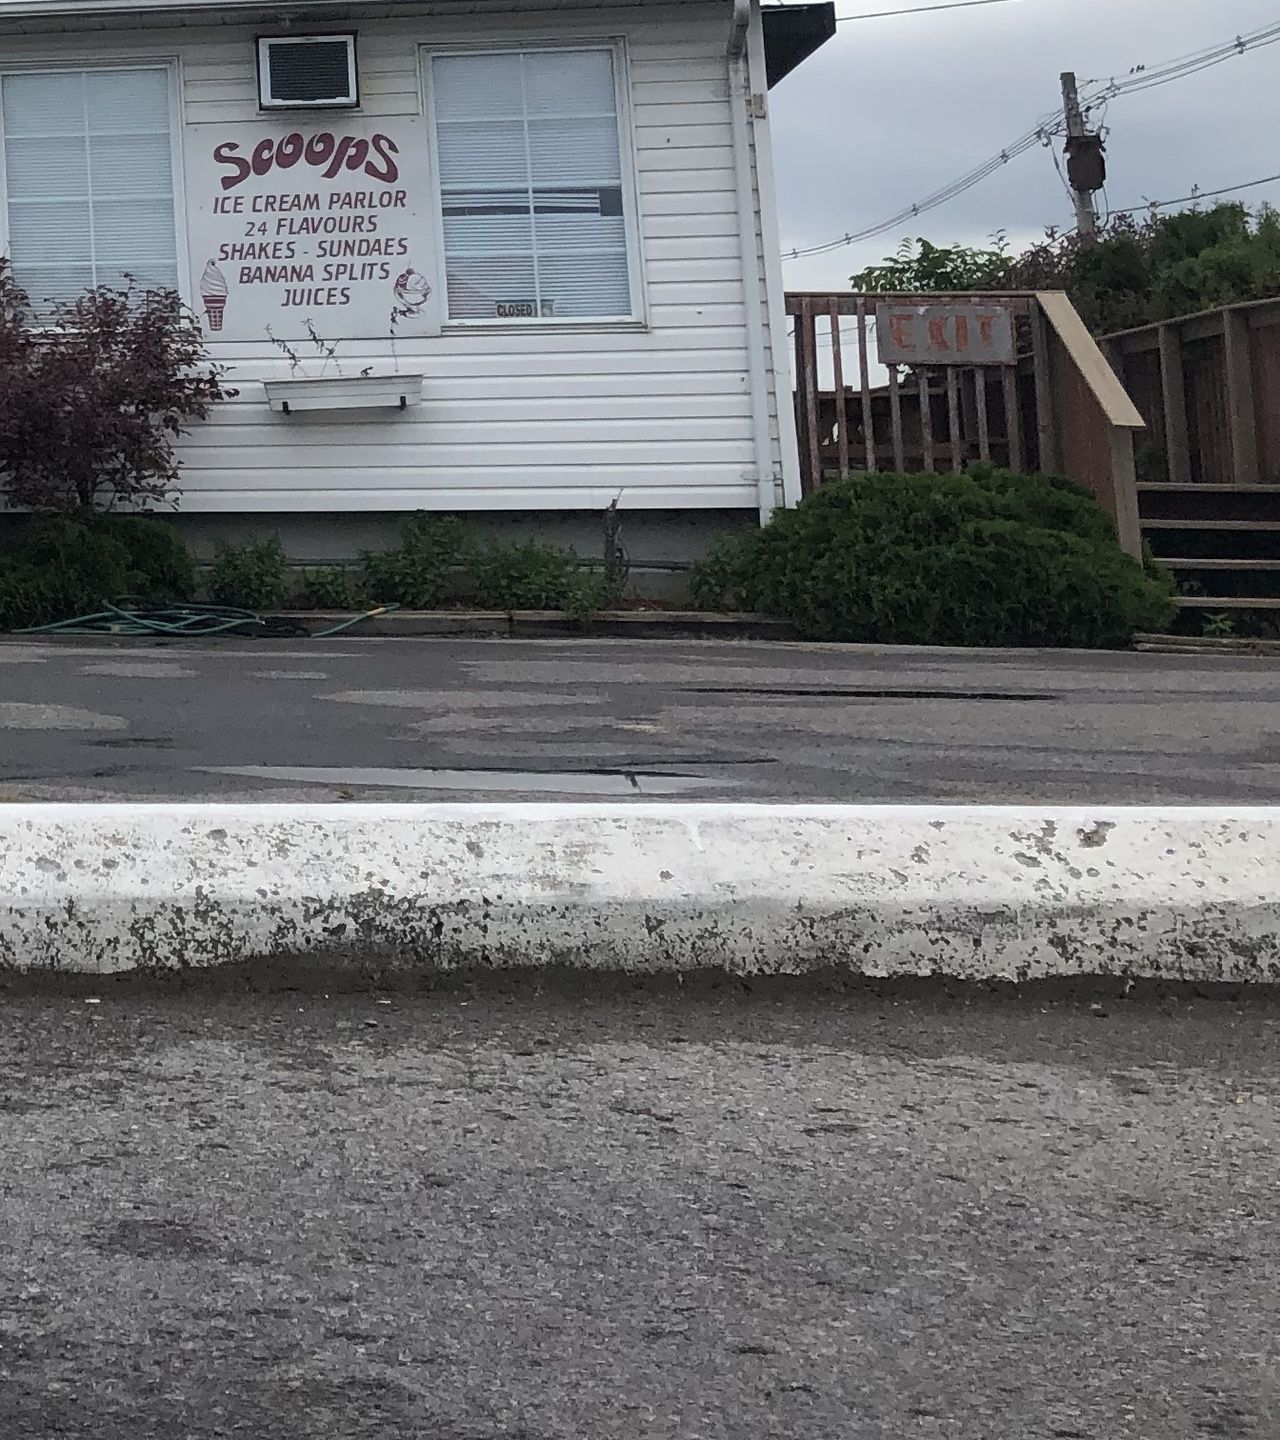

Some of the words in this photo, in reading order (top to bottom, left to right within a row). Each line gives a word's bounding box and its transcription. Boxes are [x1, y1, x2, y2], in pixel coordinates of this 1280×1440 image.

[213, 197, 244, 214] ICE
[252, 193, 320, 212] CREAM
[328, 190, 407, 209] PARLOR
[244, 221, 268, 237] 24
[276, 214, 378, 235] FLAVOURS
[218, 240, 296, 261] SHAKES
[316, 237, 408, 258] SUNDAES
[239, 263, 314, 284] BANANA
[322, 262, 390, 280] SPLITS
[281, 287, 350, 307] JUICES
[496, 304, 533, 317] CLOSED
[890, 314, 1000, 352] EXIT
